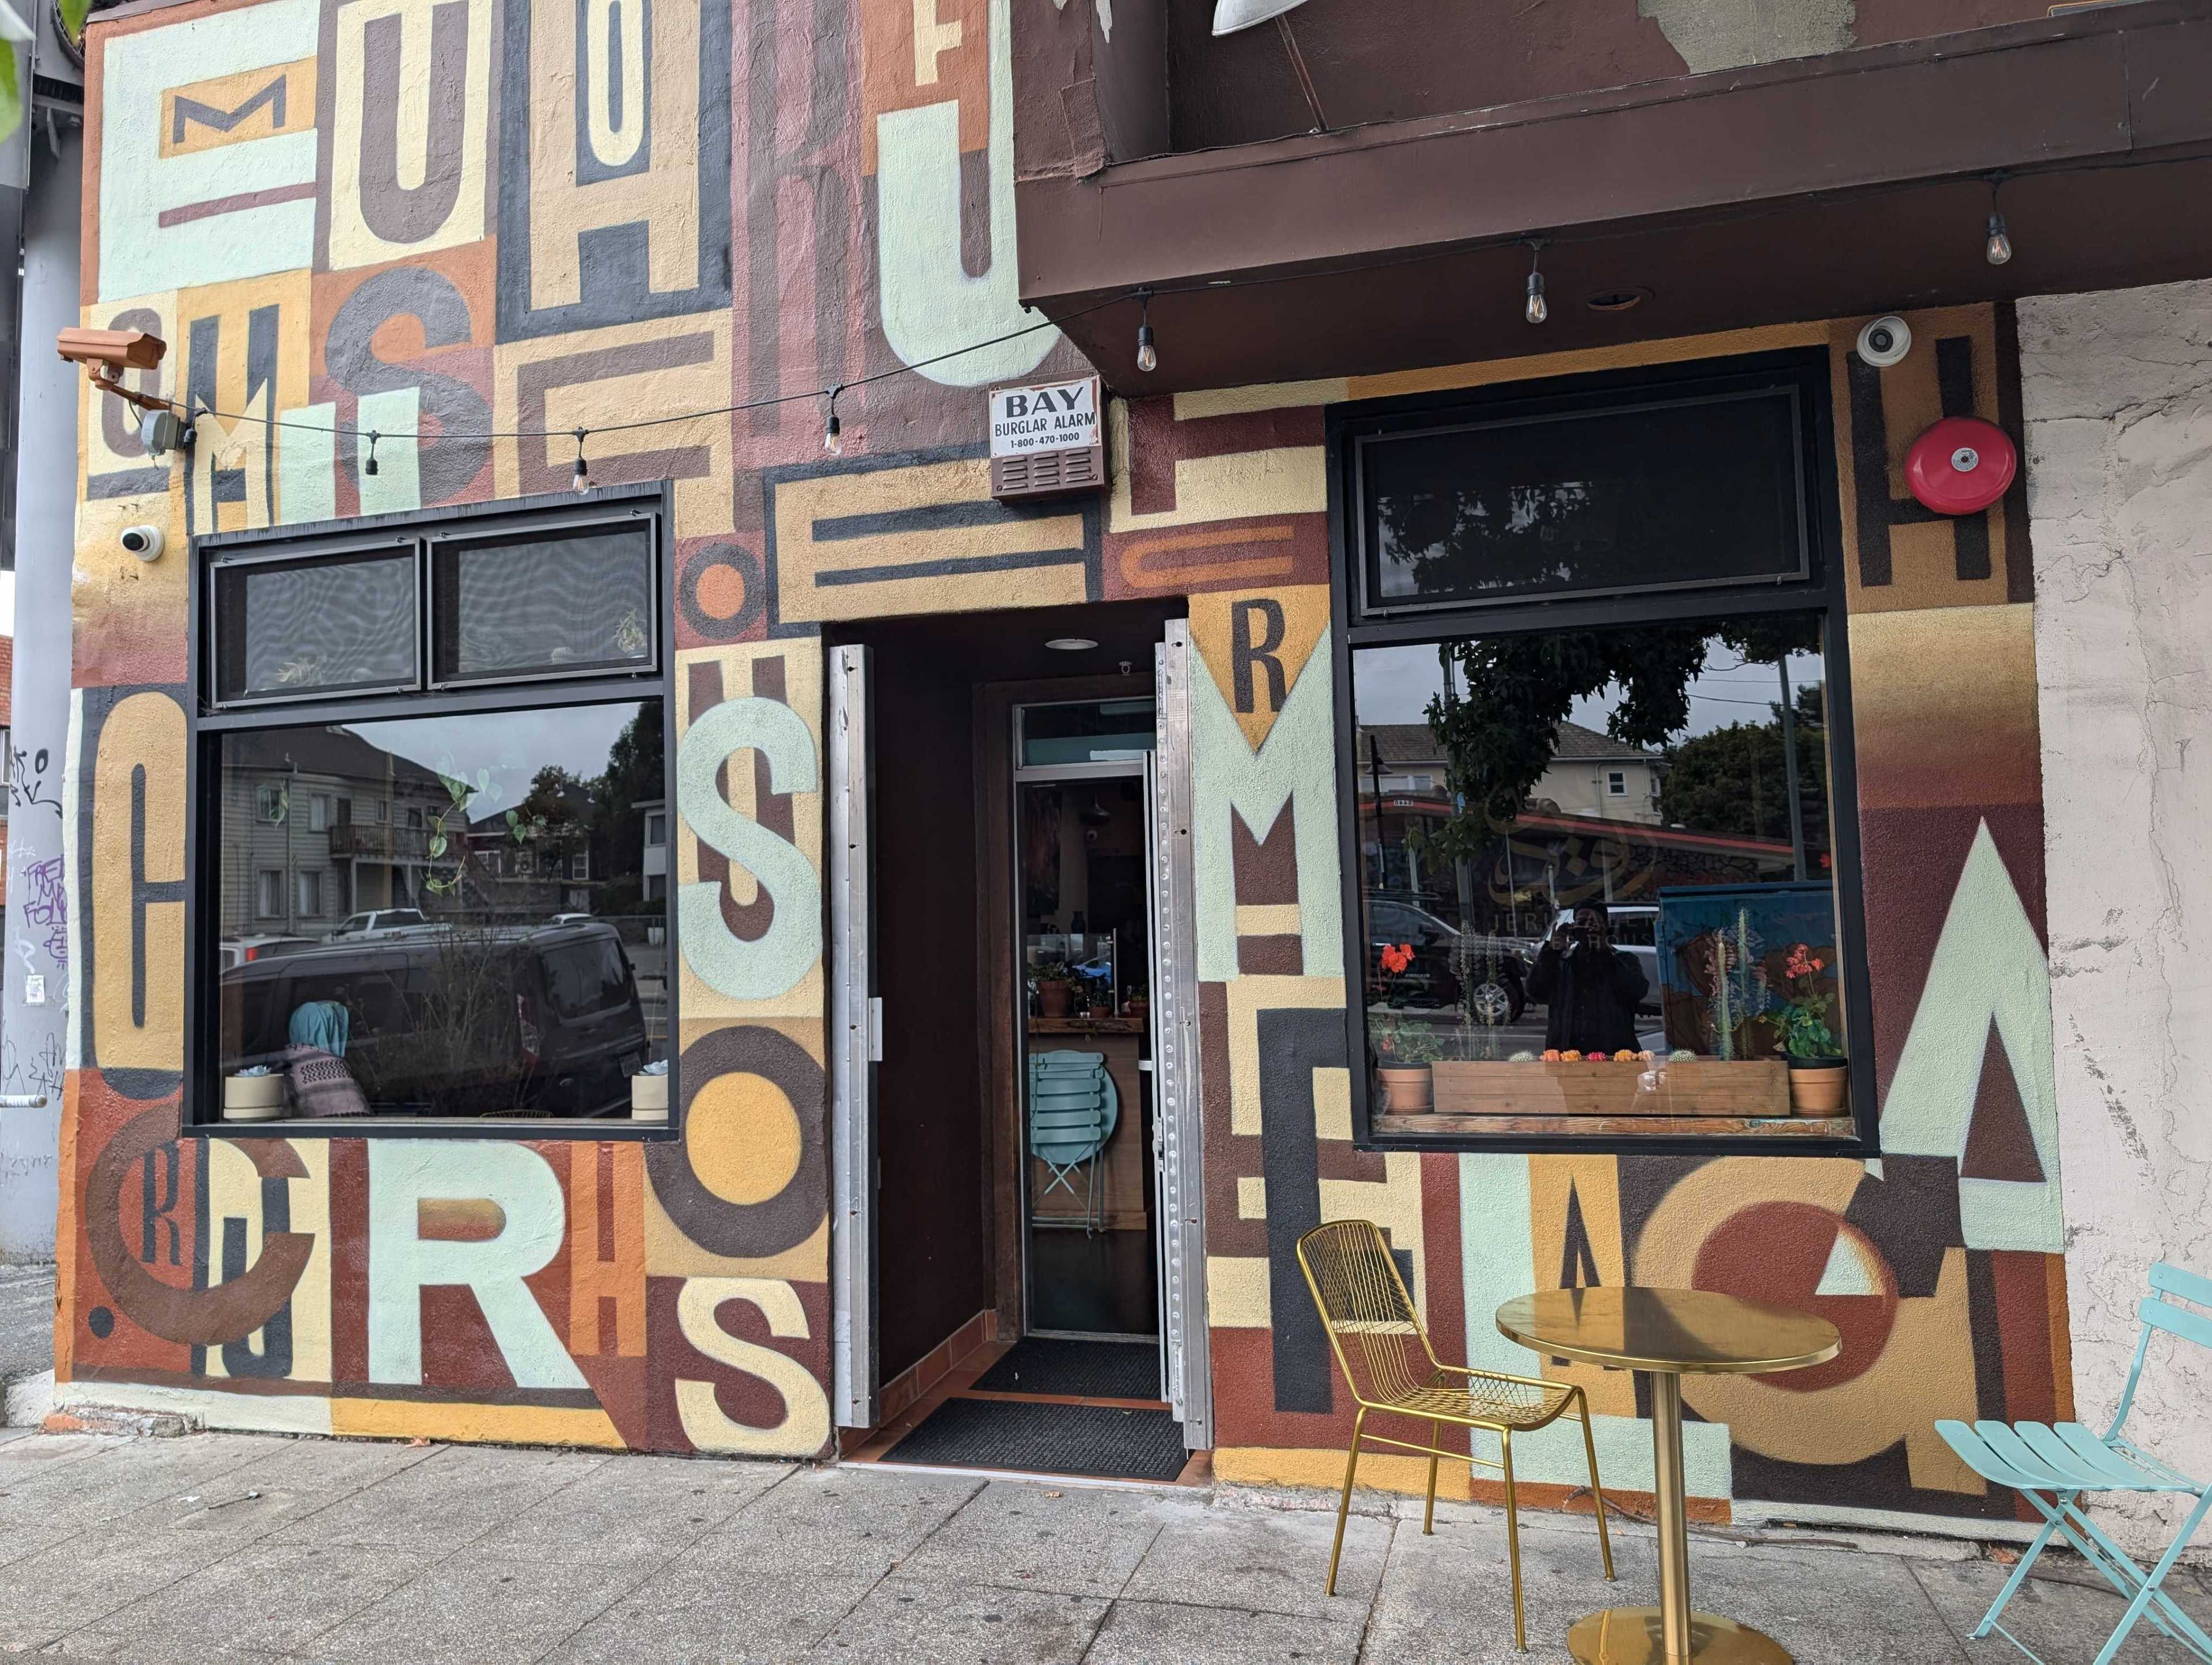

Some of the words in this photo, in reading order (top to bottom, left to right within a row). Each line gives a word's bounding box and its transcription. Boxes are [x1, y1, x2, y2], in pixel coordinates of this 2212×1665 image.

[1006, 386, 1084, 418] BAY
[995, 418, 1047, 437] BURGLAR
[1054, 411, 1096, 430] ALARM
[1010, 432, 1080, 448] 1-800-470-1000
[1231, 598, 1286, 714] R
[676, 696, 824, 1001] S
[1494, 911, 1657, 931] JERALE
[1588, 933, 1659, 950] HOUS
[368, 1139, 591, 1390] R
[675, 1277, 831, 1457] S
